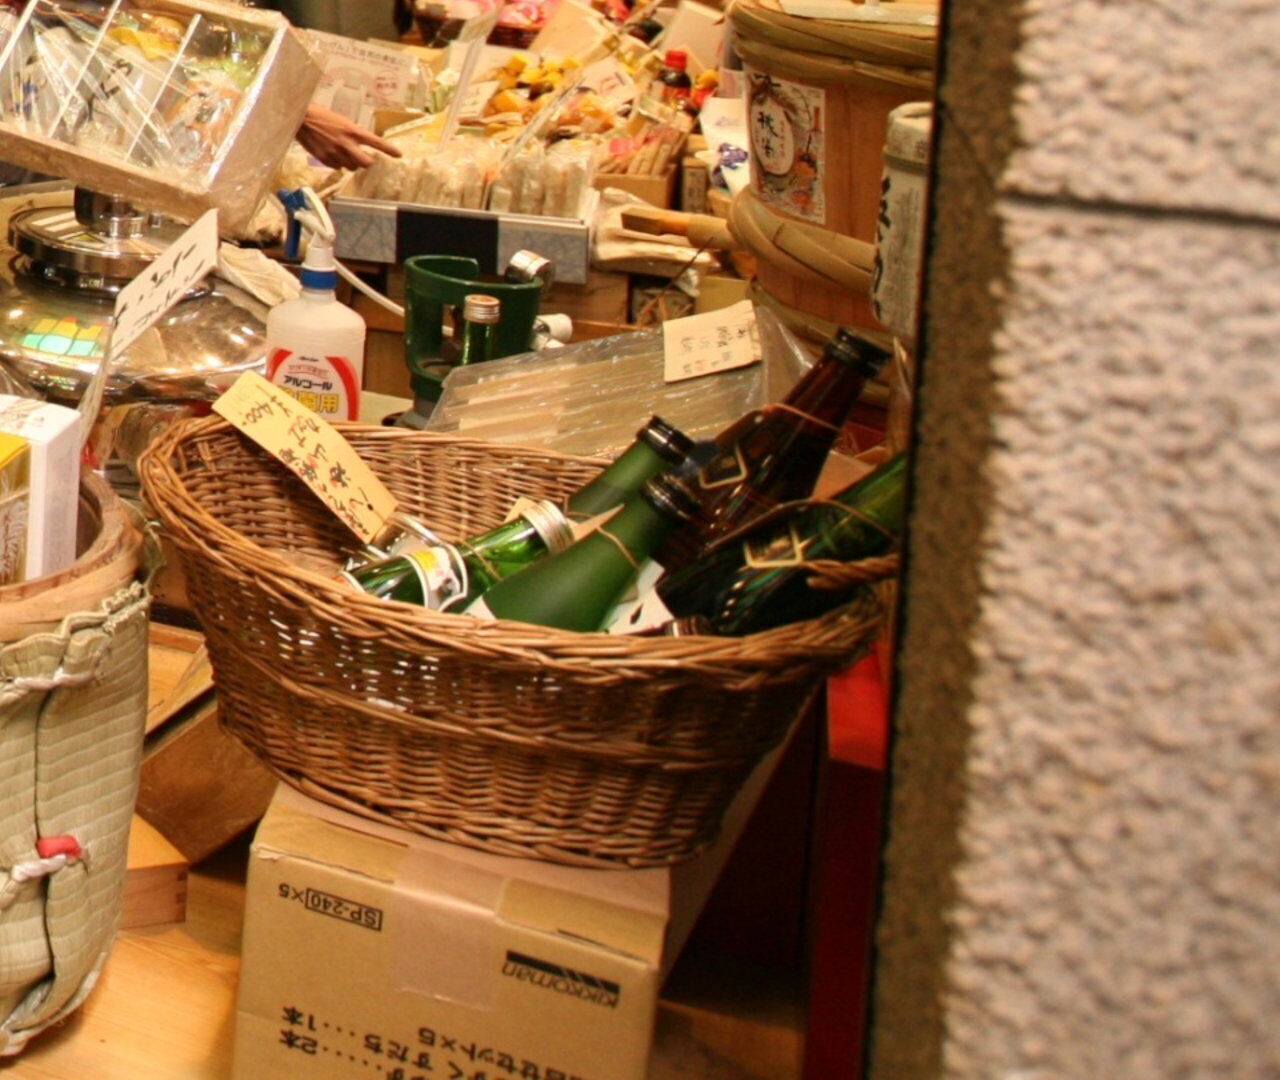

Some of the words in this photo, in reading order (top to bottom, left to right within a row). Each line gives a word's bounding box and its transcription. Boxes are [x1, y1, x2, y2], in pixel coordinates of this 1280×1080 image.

[284, 375, 333, 400] アルコール
